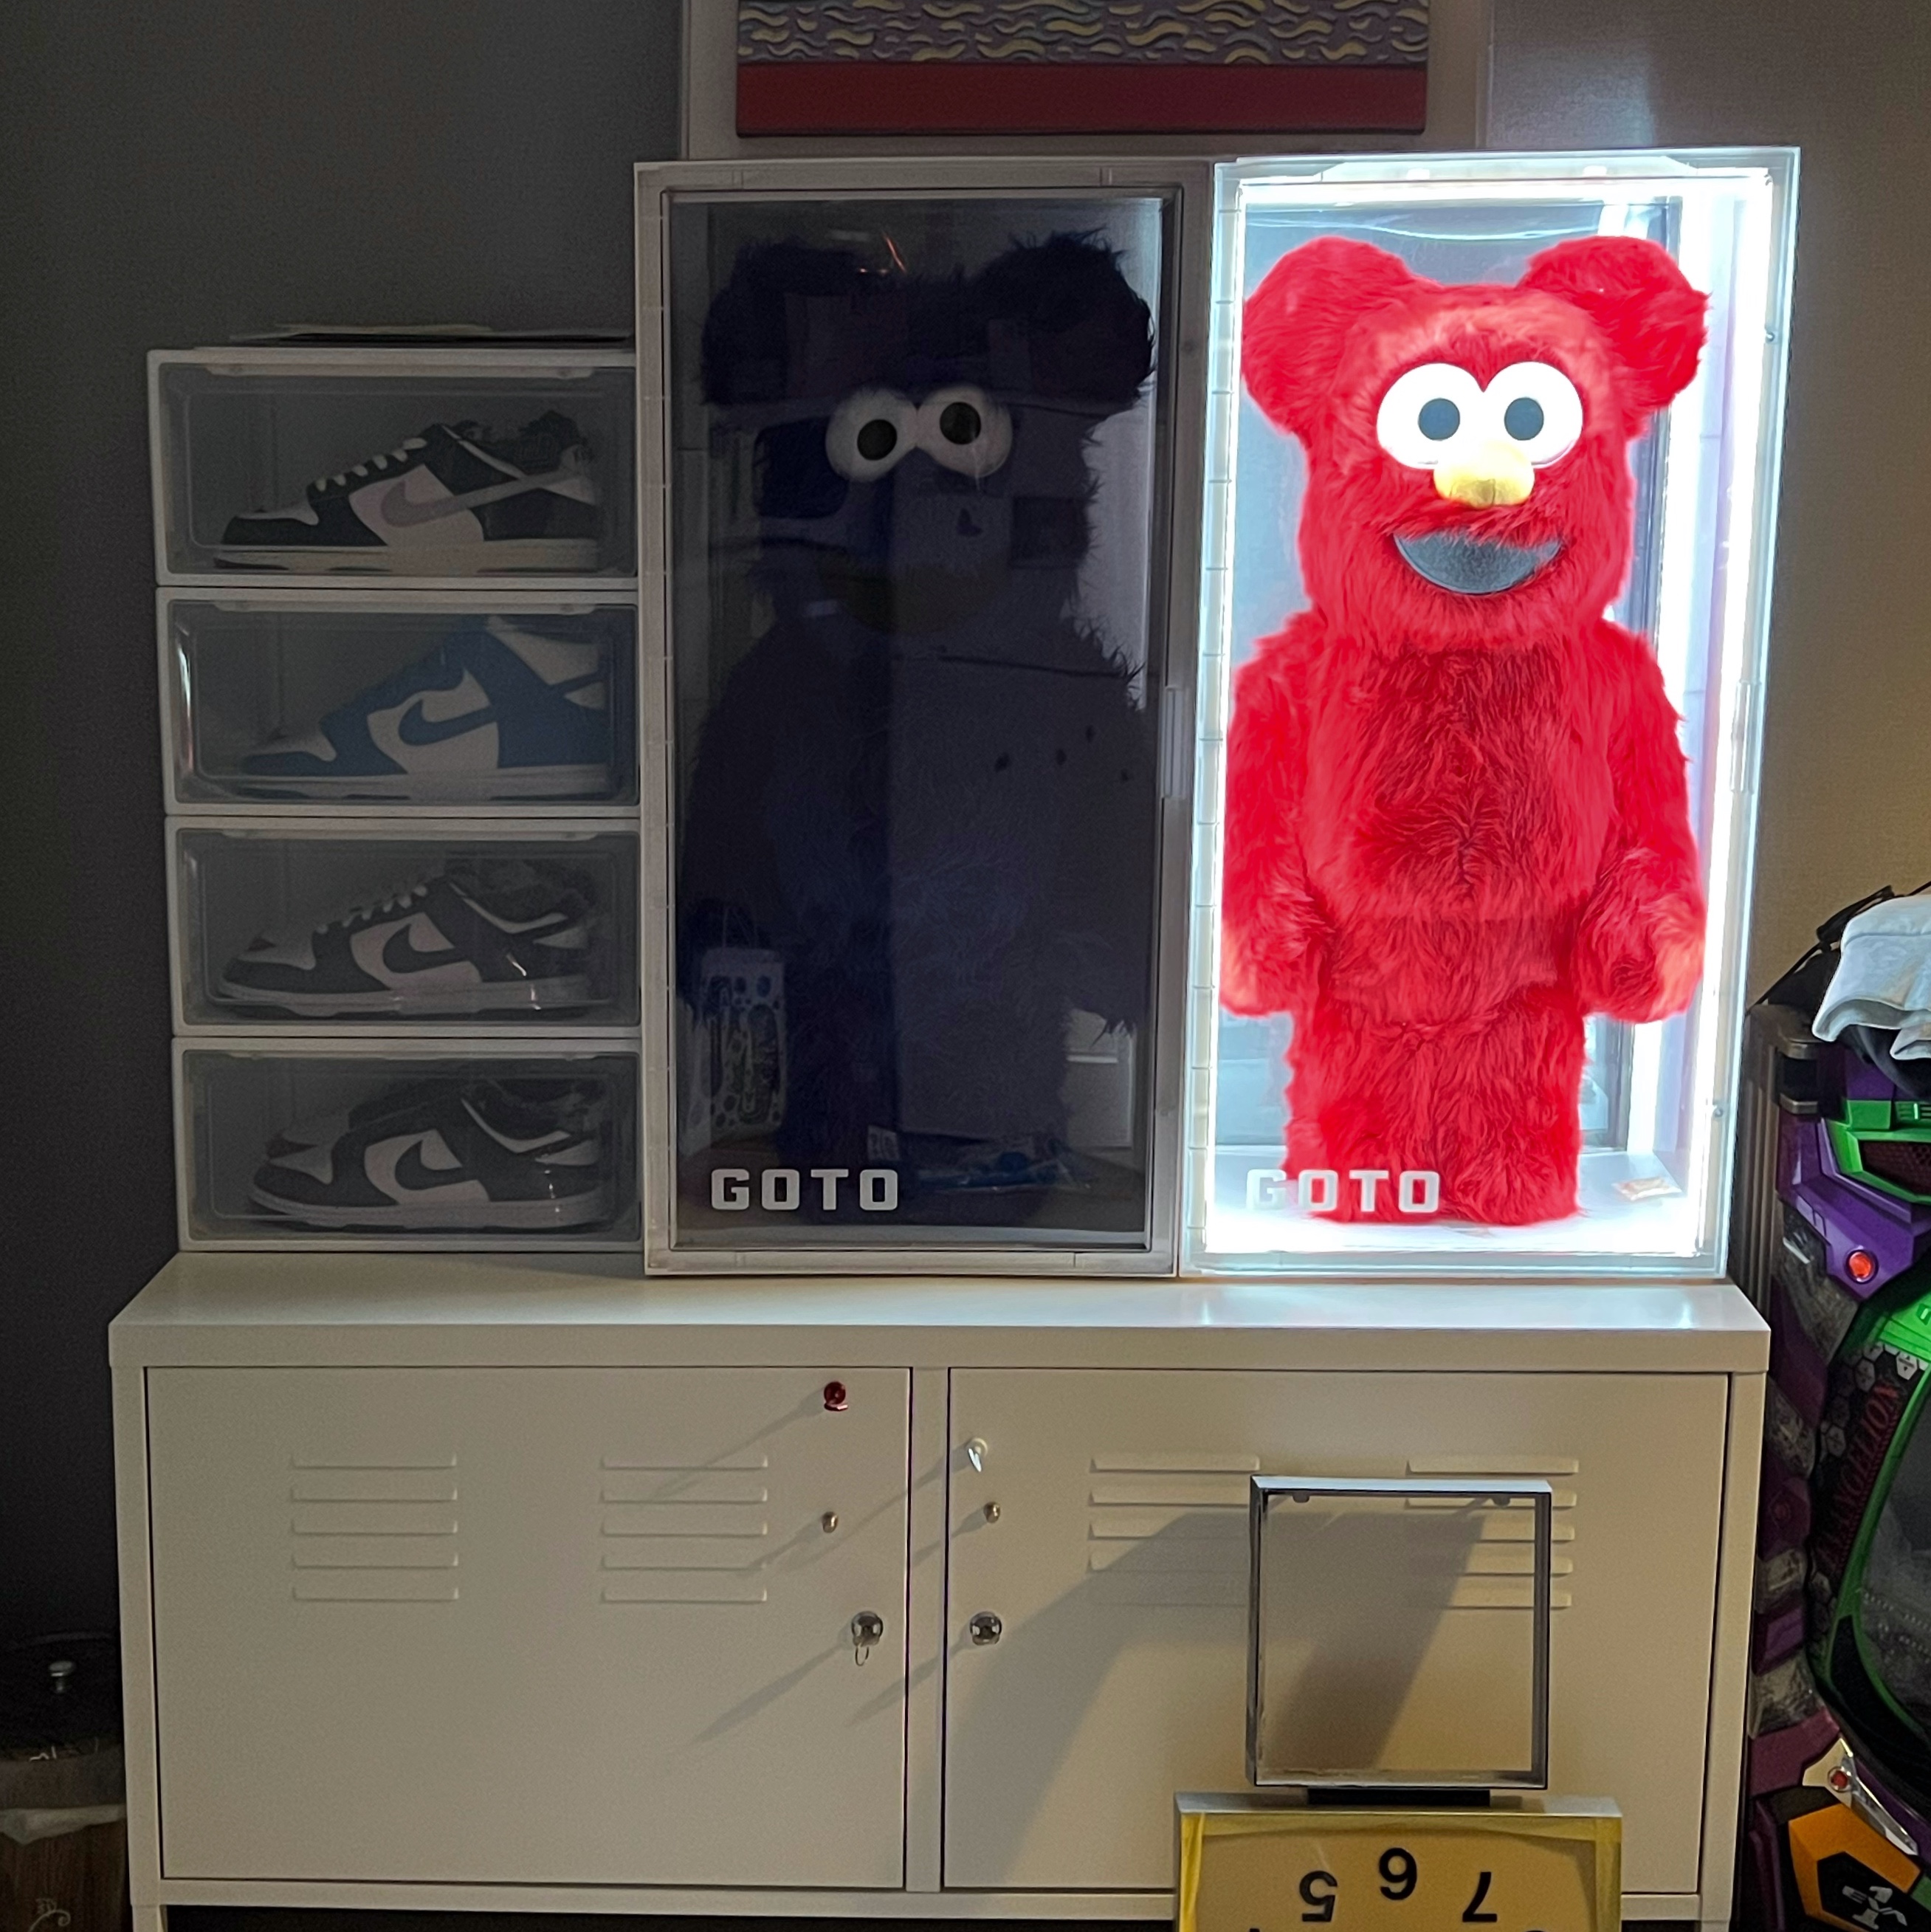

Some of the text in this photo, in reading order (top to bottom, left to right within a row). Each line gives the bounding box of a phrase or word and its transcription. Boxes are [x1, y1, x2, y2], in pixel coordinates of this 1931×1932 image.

[711, 1168, 898, 1211] GOTO
[1246, 1169, 1440, 1213] GOTO
[1298, 1870, 1338, 1922] 5
[1378, 1847, 1417, 1900] 6
[1462, 1871, 1498, 1922] 7
